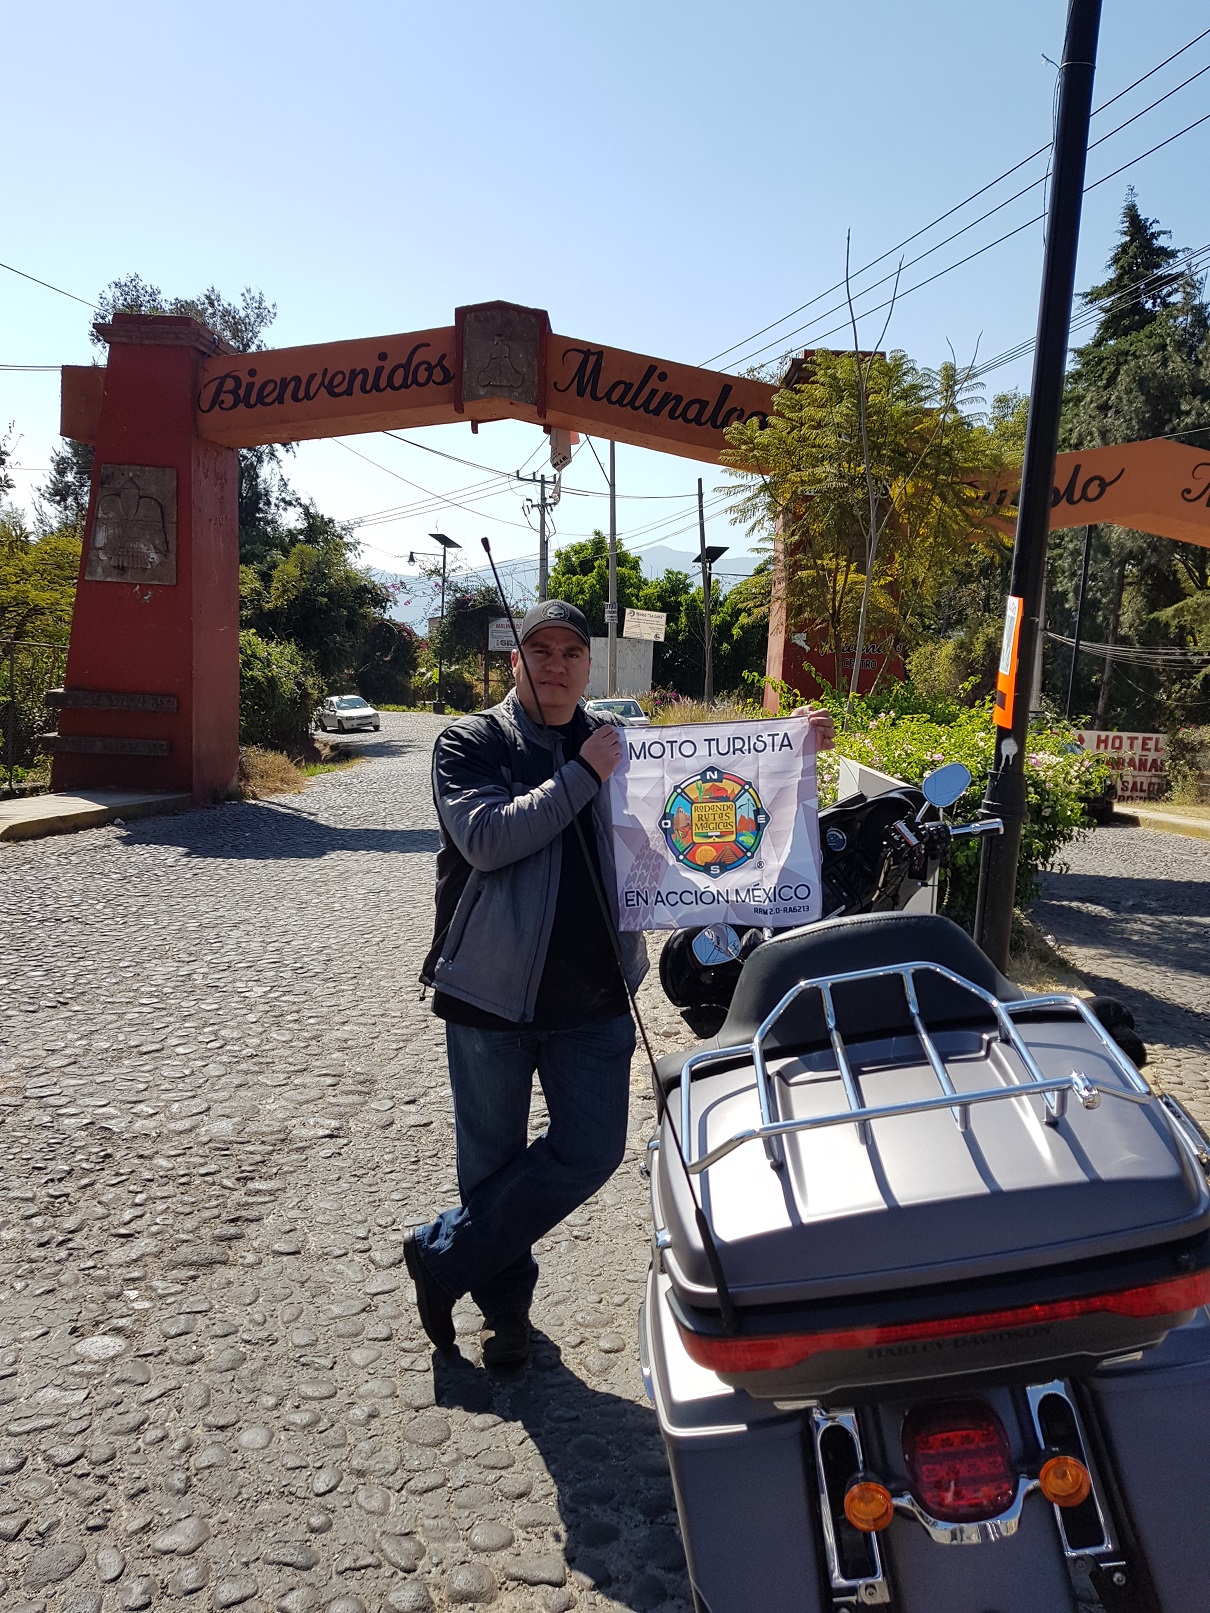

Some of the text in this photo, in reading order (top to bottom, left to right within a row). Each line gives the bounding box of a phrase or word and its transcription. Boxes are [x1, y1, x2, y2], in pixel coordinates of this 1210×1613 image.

[200, 342, 769, 431] Bienvenidos Malinalco
[843, 657, 878, 670] CETRO
[628, 731, 794, 761] MOTO TURISTA
[1095, 734, 1164, 754] HOTEL
[706, 771, 718, 780] N
[757, 815, 766, 823] E
[710, 865, 720, 874] S
[624, 882, 811, 908] EN ACCIÓN MÉXICO
[753, 907, 768, 915] RRM
[867, 1327, 1051, 1359] HARLEY-DAVIDSON
